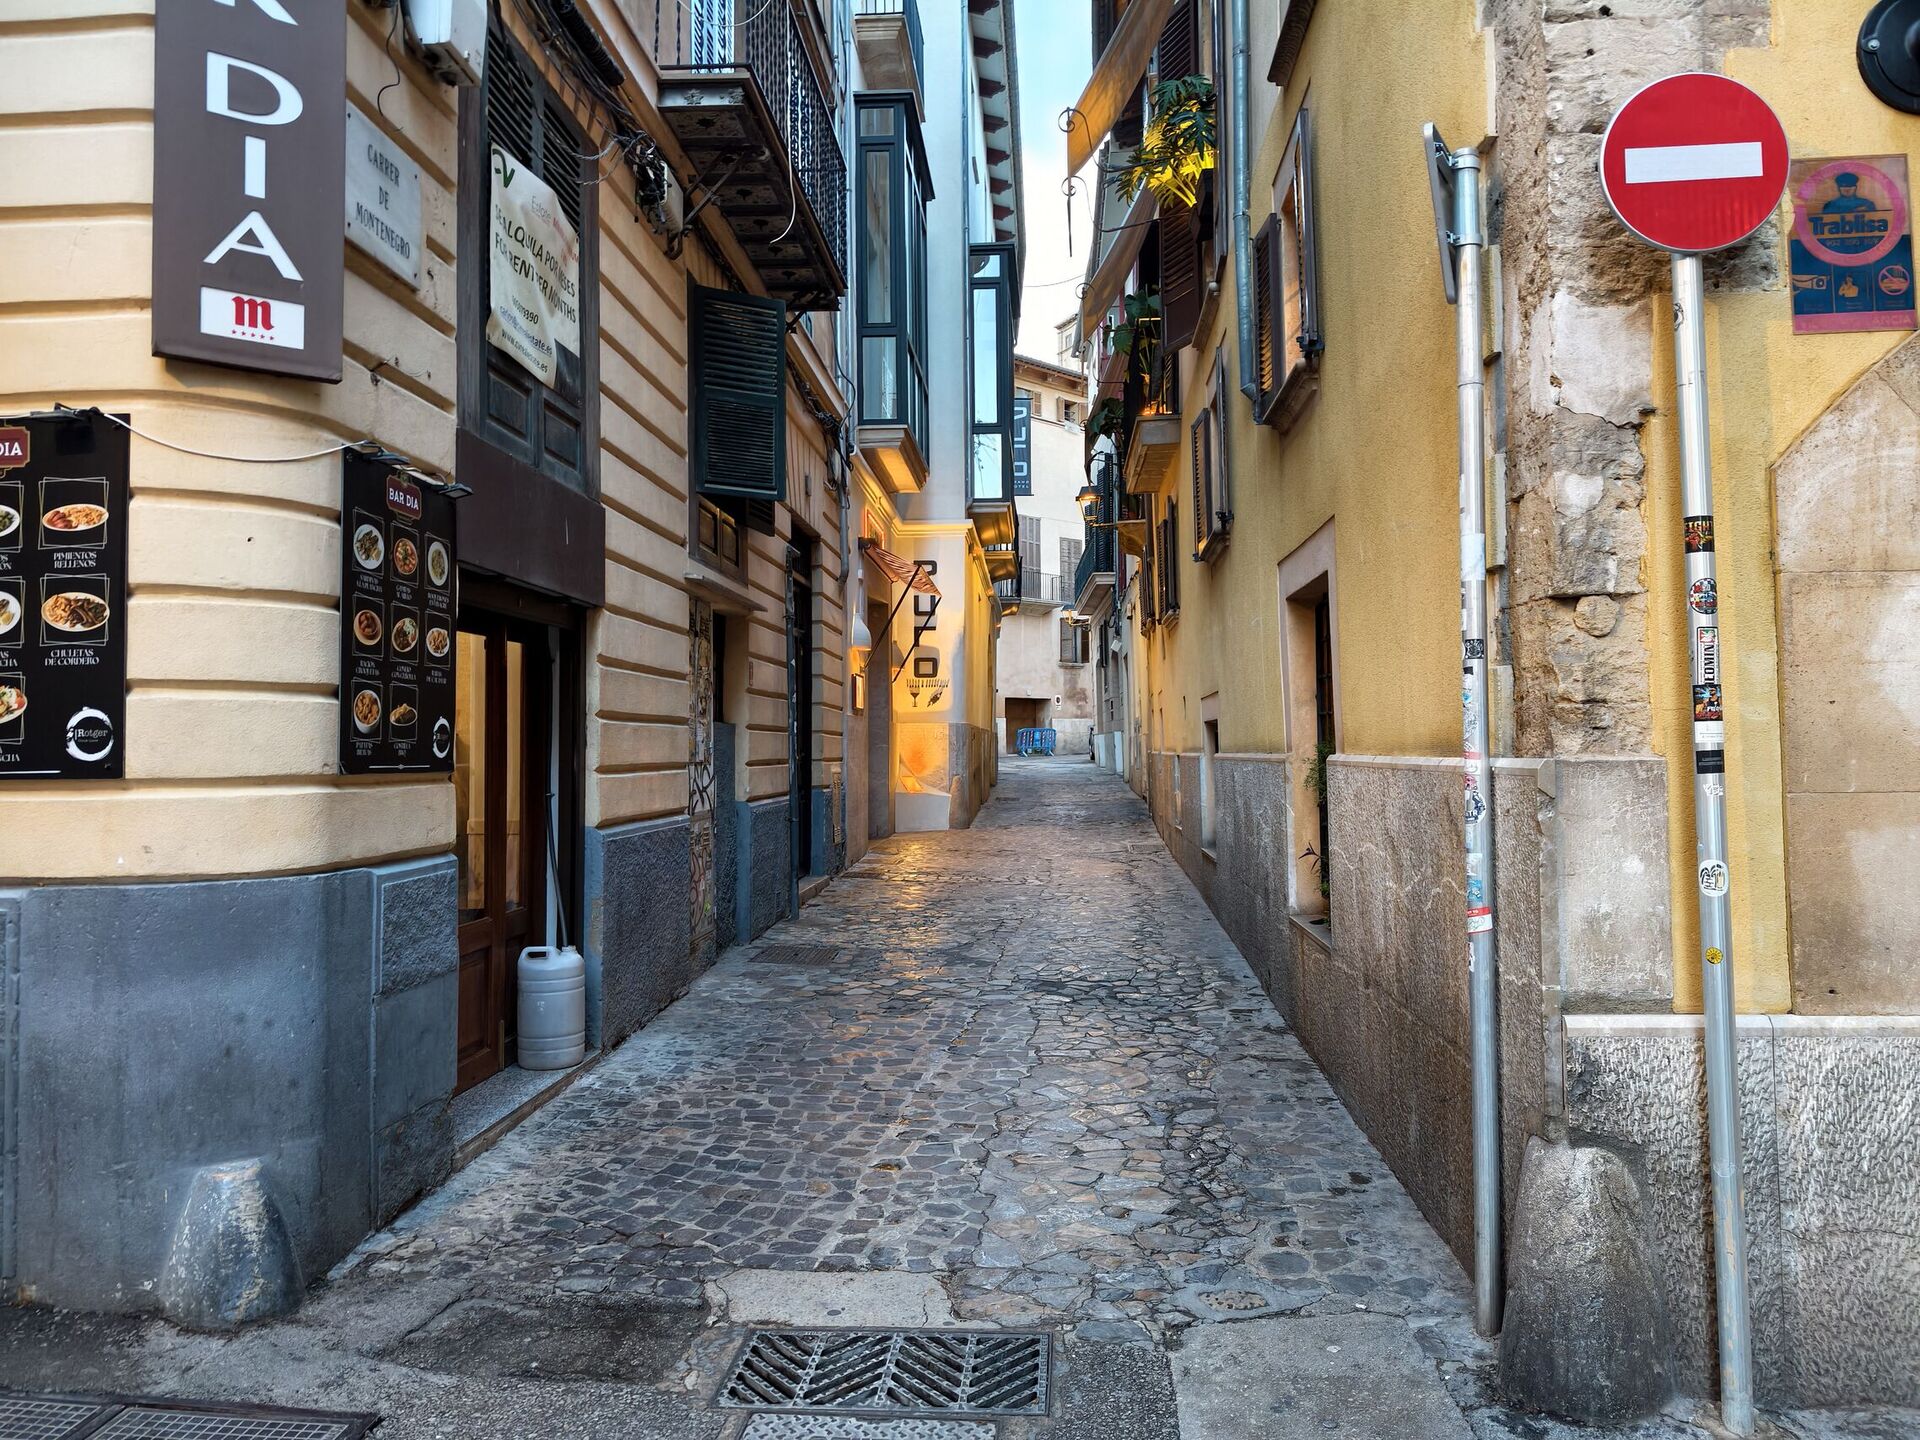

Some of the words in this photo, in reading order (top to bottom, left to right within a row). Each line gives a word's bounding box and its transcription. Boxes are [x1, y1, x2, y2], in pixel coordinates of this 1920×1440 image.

[205, 51, 304, 282] DIA
[367, 144, 400, 187] CARRER
[378, 185, 389, 210] DE
[355, 202, 411, 260] MONTENEGRO
[1807, 214, 1888, 235] Trablisa
[502, 216, 543, 262] ALQUILA
[545, 250, 558, 276] POR
[548, 286, 577, 323] MONTHS
[389, 487, 405, 504] BAR
[406, 495, 419, 510] DIA
[53, 551, 97, 560] PIMIENTOS
[54, 559, 97, 569] RELLENOS
[44, 657, 57, 666] DE
[57, 656, 100, 666] CORDERO
[50, 648, 94, 658] CHULETAS
[77, 728, 108, 739] Rotger
